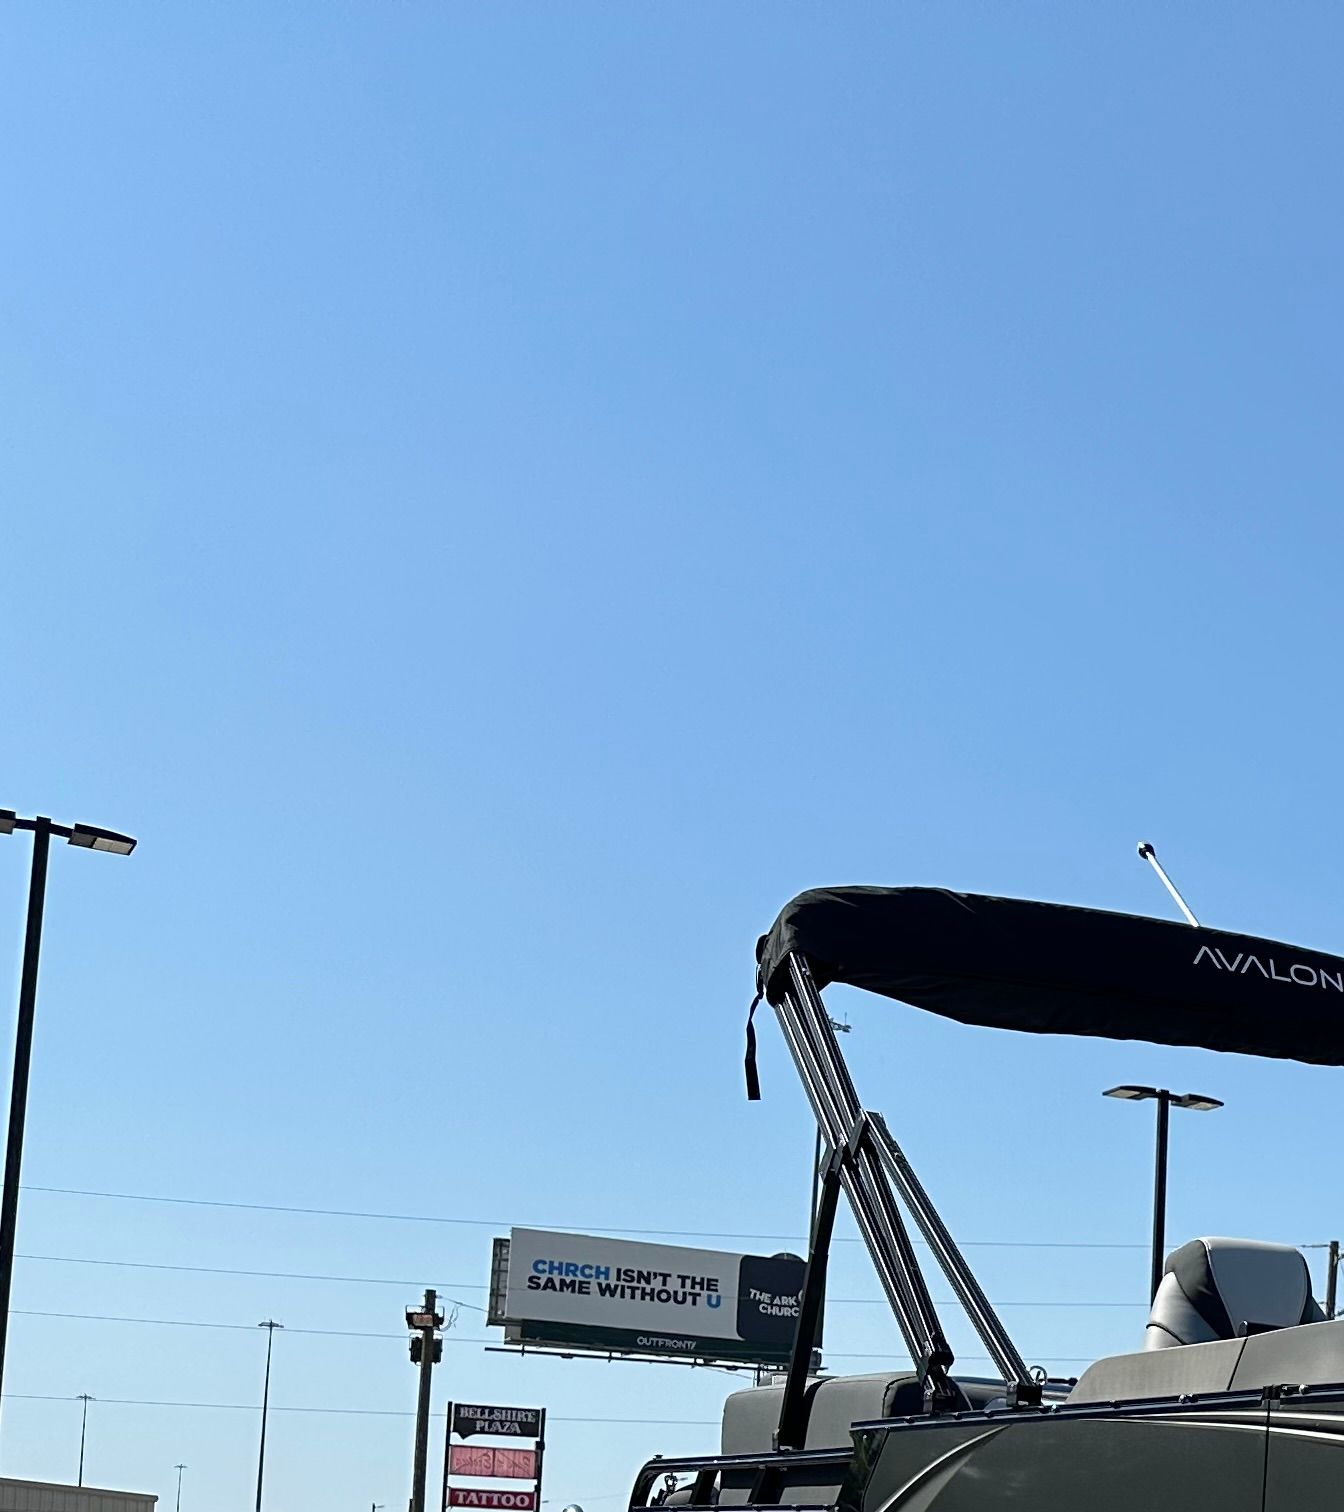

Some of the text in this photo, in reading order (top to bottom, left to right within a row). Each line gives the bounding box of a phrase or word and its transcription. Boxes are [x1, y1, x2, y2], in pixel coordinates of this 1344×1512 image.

[1193, 945, 1344, 992] AVALON
[532, 1259, 719, 1292] CHRCH ISN'T THE
[527, 1275, 721, 1309] SAME WITHOUT U
[749, 1288, 797, 1306] THE ARK
[759, 1303, 800, 1317] CHURC
[460, 1407, 536, 1423] BELLSHIRE
[475, 1420, 521, 1434] PLAZA
[455, 1491, 530, 1507] TATTOO
